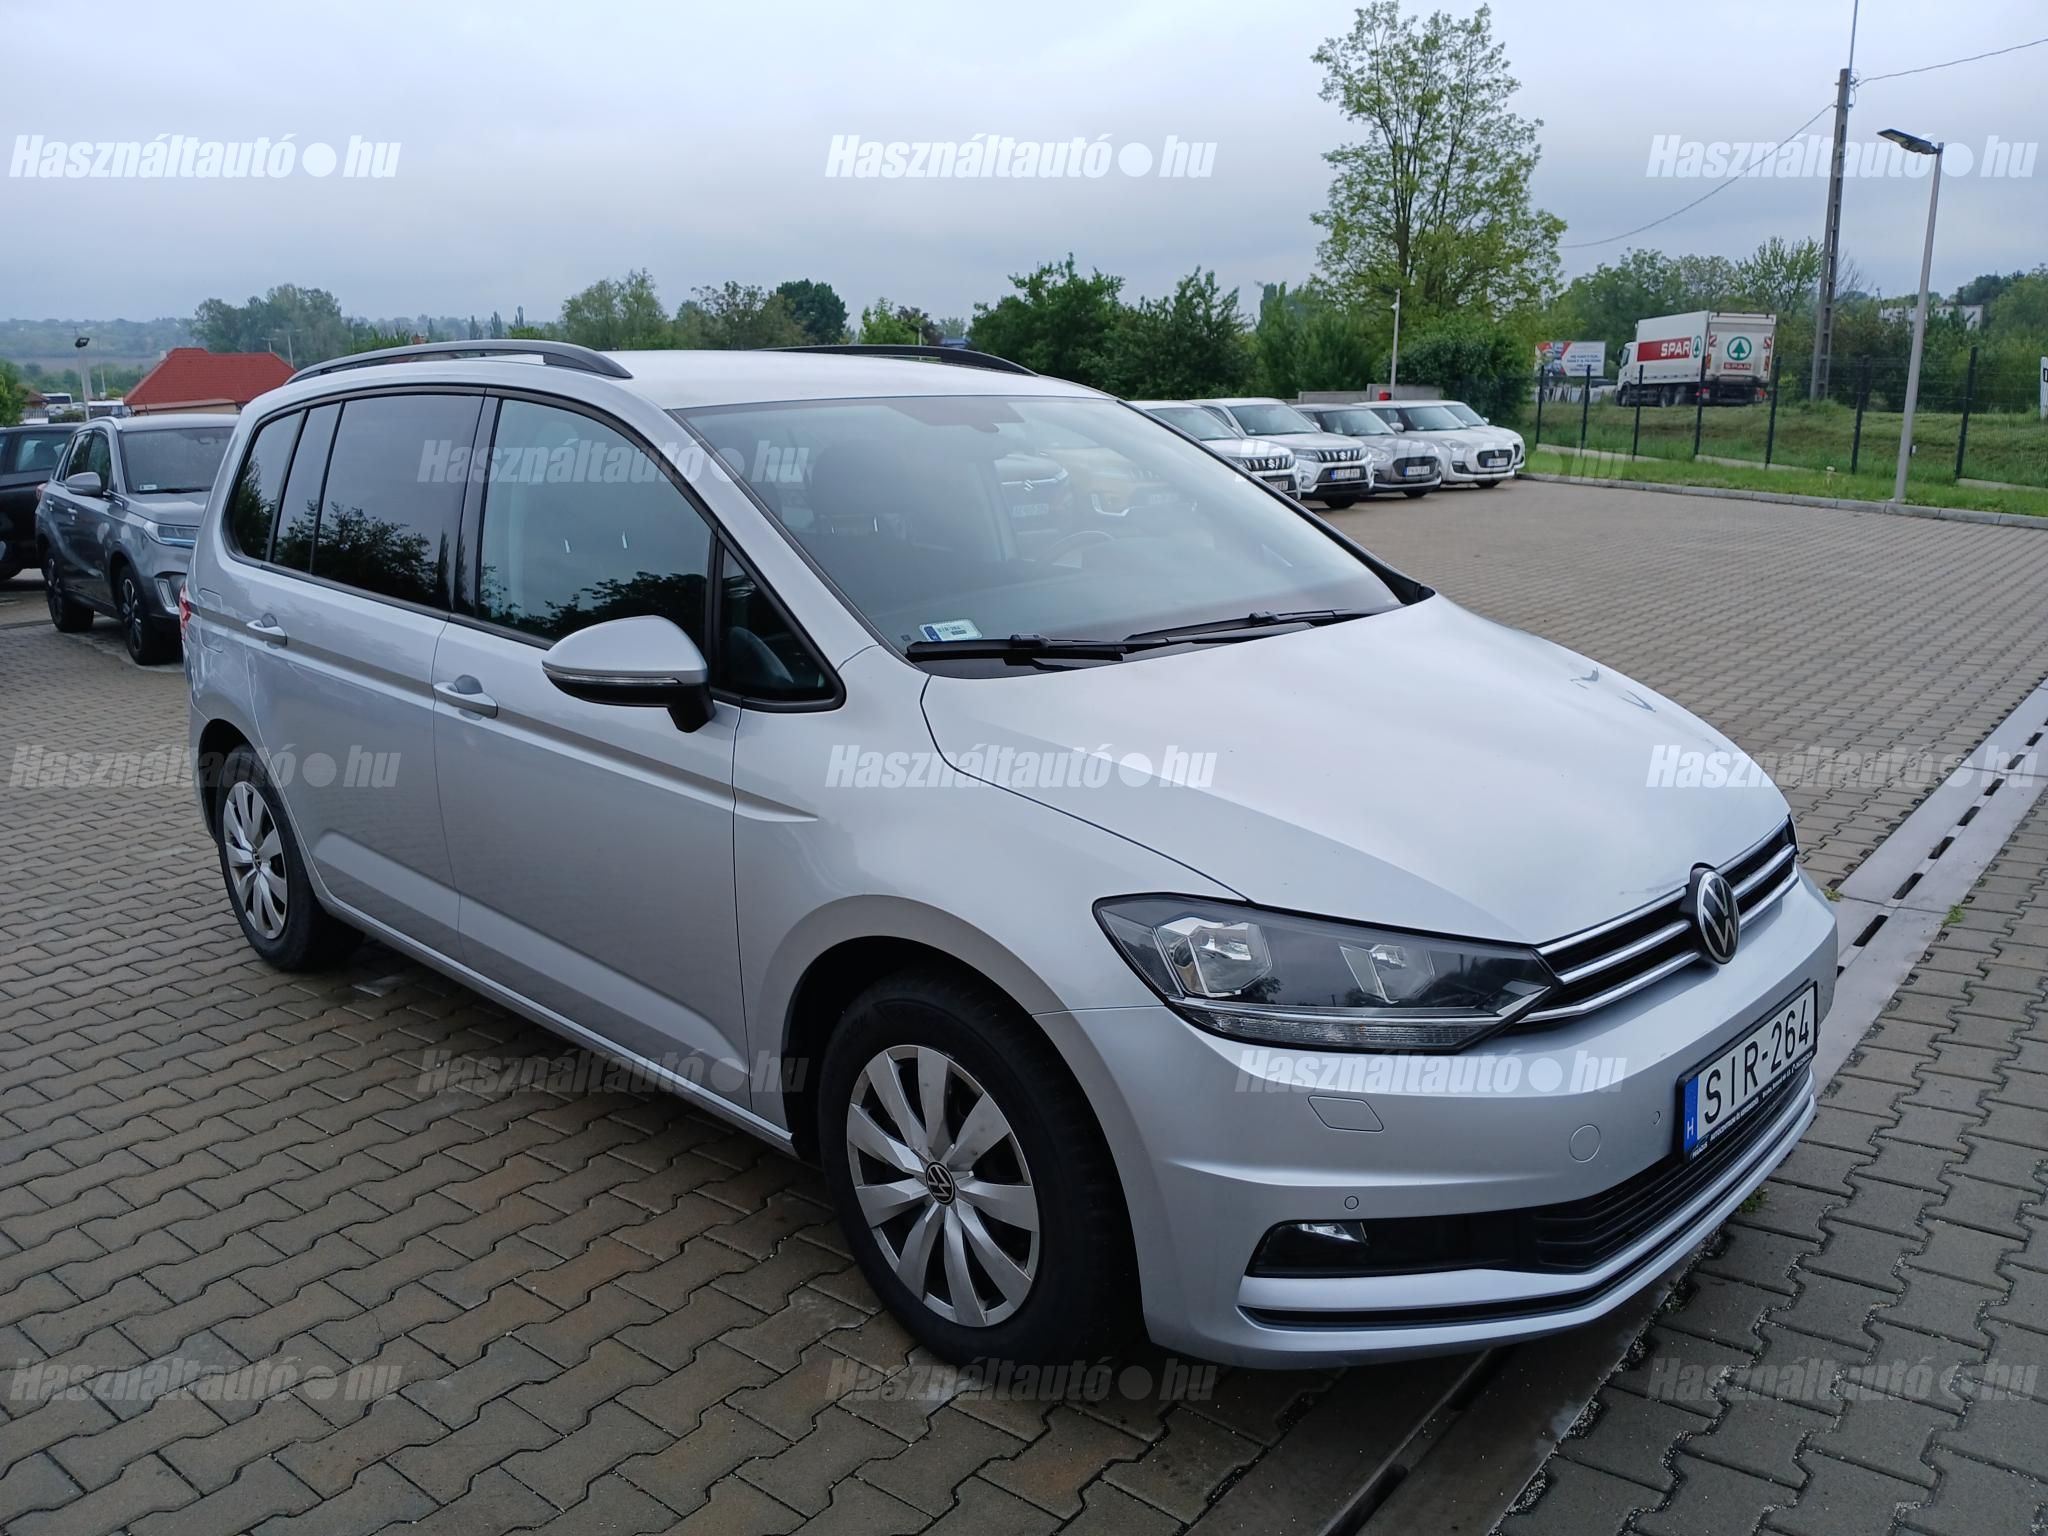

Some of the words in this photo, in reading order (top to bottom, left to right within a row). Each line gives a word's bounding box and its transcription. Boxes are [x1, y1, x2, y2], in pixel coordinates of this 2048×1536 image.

[1660, 340, 1690, 358] SPAR
[1686, 1117, 1695, 1140] H
[1704, 999, 1809, 1124] SIR-264
